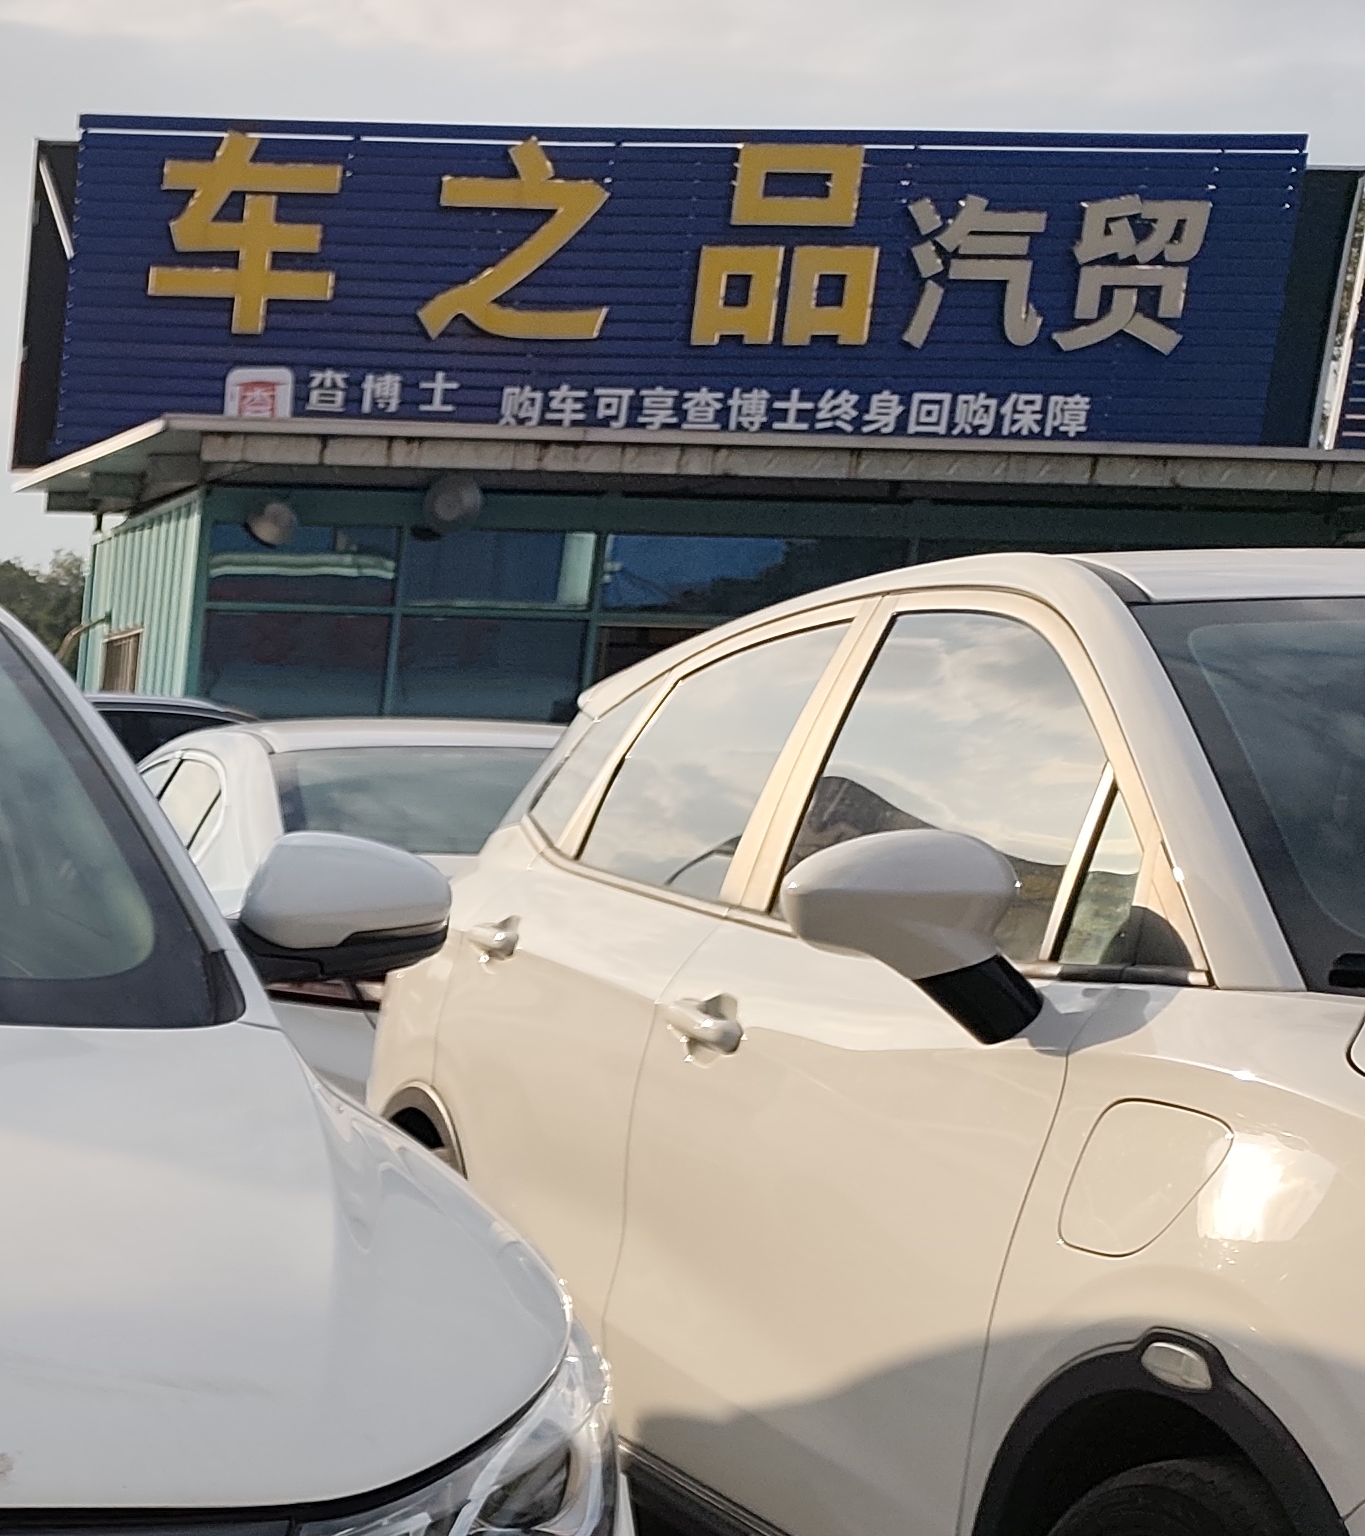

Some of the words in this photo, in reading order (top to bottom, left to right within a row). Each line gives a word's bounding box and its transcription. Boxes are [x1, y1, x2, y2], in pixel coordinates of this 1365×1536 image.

[148, 131, 1213, 352] 车之品汽贸
[305, 368, 461, 414] 查博士
[499, 385, 1092, 437] 购车可享查博士终身回购保障
